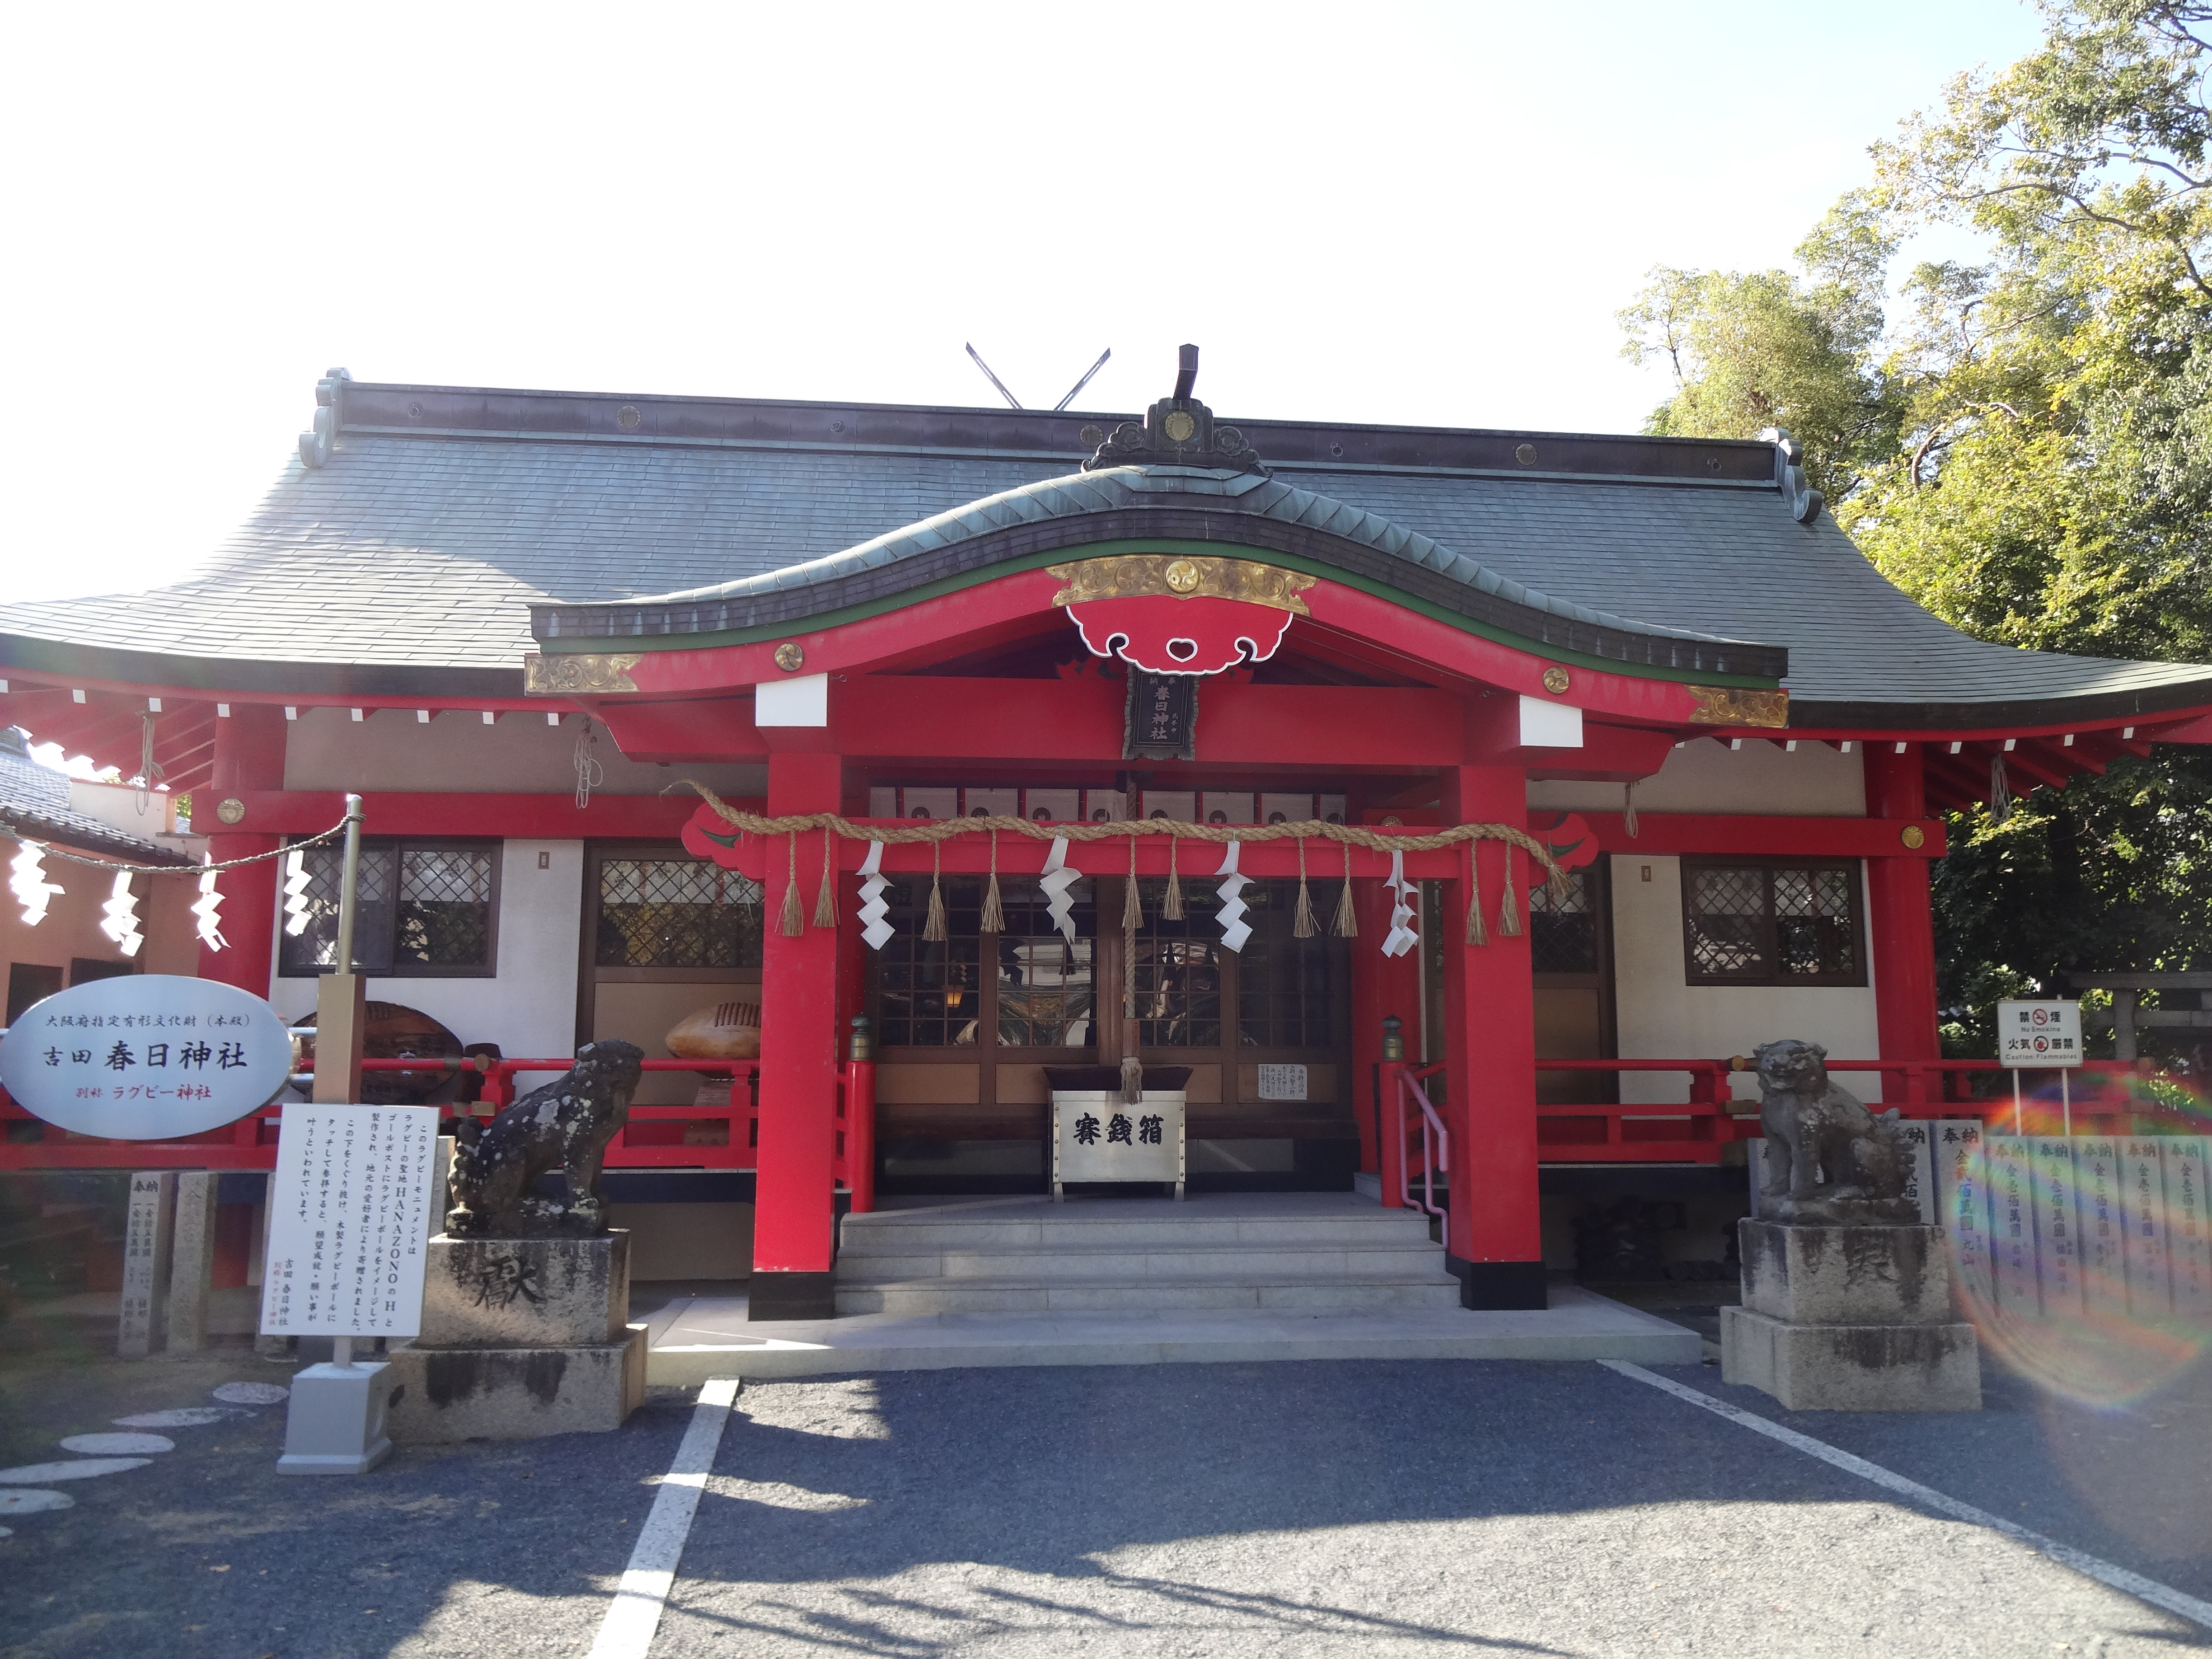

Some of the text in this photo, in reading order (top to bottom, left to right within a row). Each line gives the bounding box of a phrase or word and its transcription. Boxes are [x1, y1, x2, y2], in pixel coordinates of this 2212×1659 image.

[1149, 685, 1170, 740] 春日神社
[2020, 1011, 2061, 1023] 禁 煙
[2008, 1038, 2073, 1050] 火気 厳禁
[1073, 1112, 1164, 1146] 賽銭箱
[1942, 1127, 1979, 1144] 奉納
[298, 1117, 317, 1223] 叶うといわれています。
[408, 1125, 427, 1255] このラグビーモニュメントは
